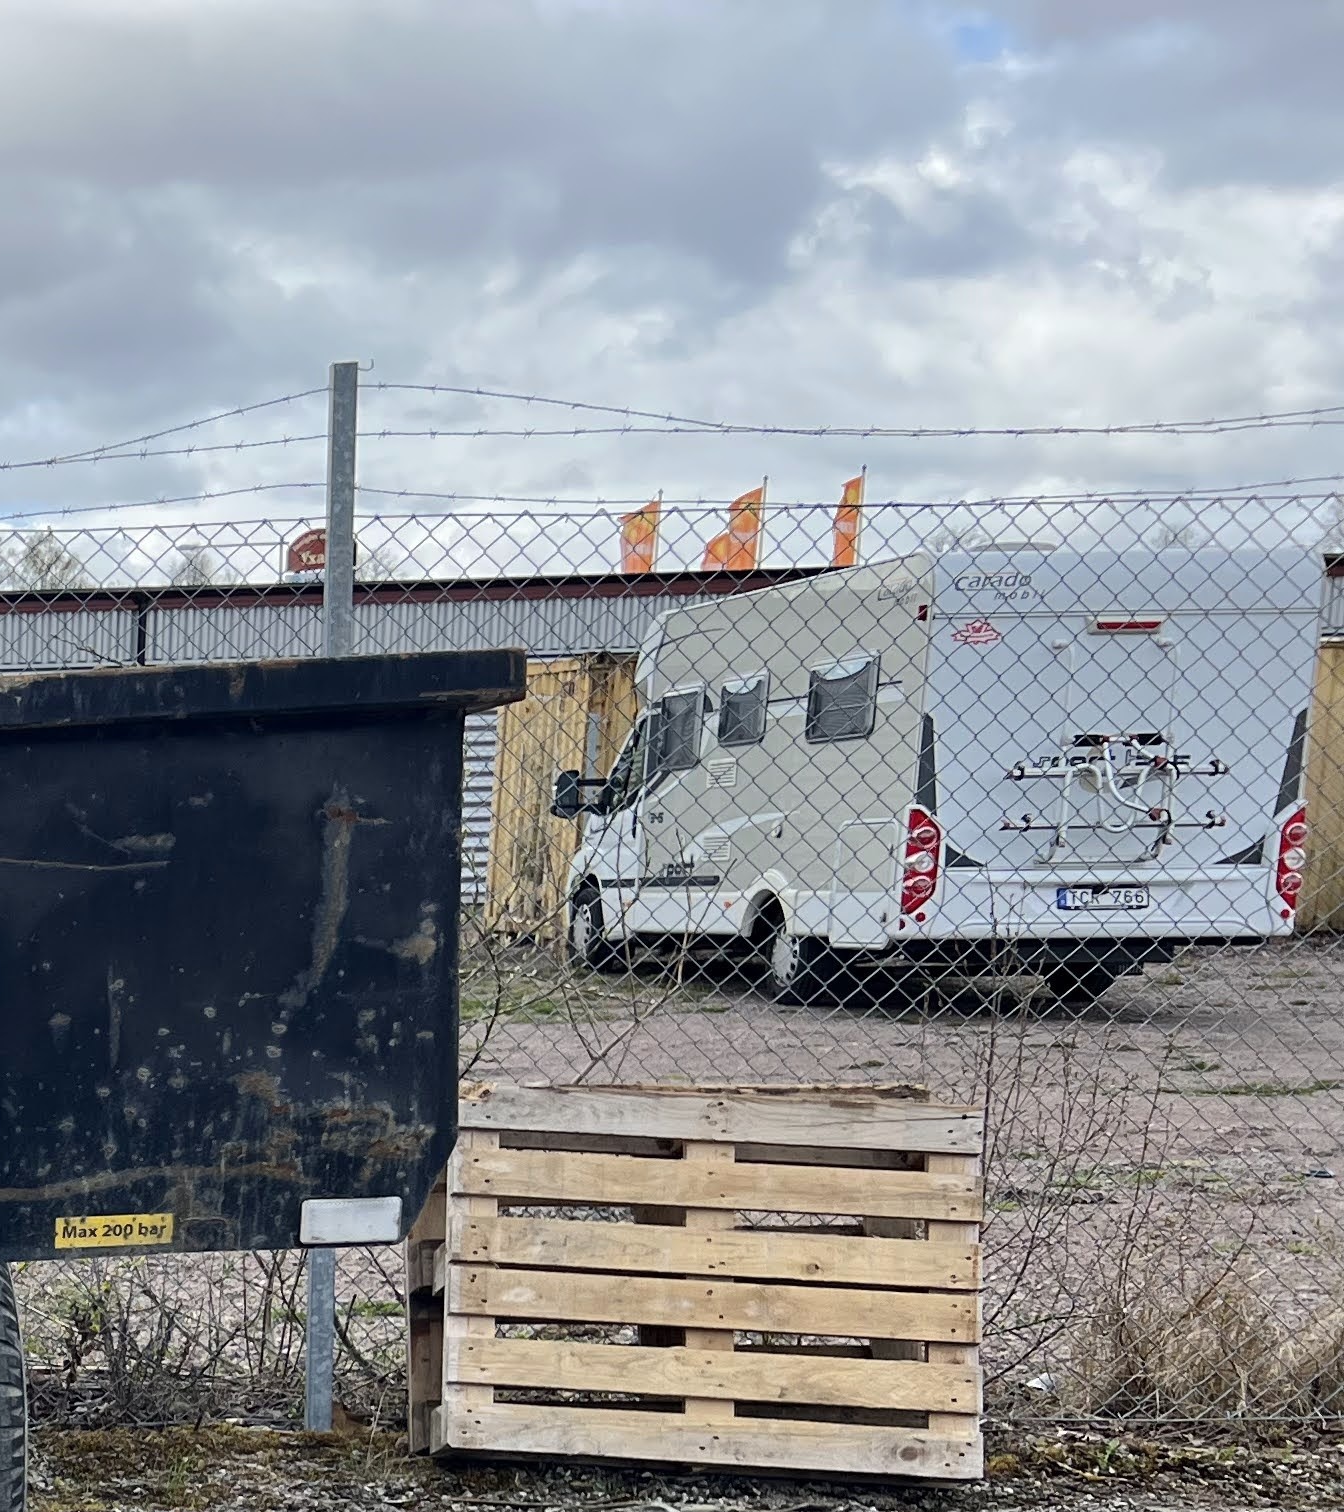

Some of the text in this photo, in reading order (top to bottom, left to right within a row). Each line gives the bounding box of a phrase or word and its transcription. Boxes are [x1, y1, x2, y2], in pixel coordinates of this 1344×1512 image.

[1112, 890, 1144, 904] 766
[62, 1222, 167, 1239] Max 200 bar
